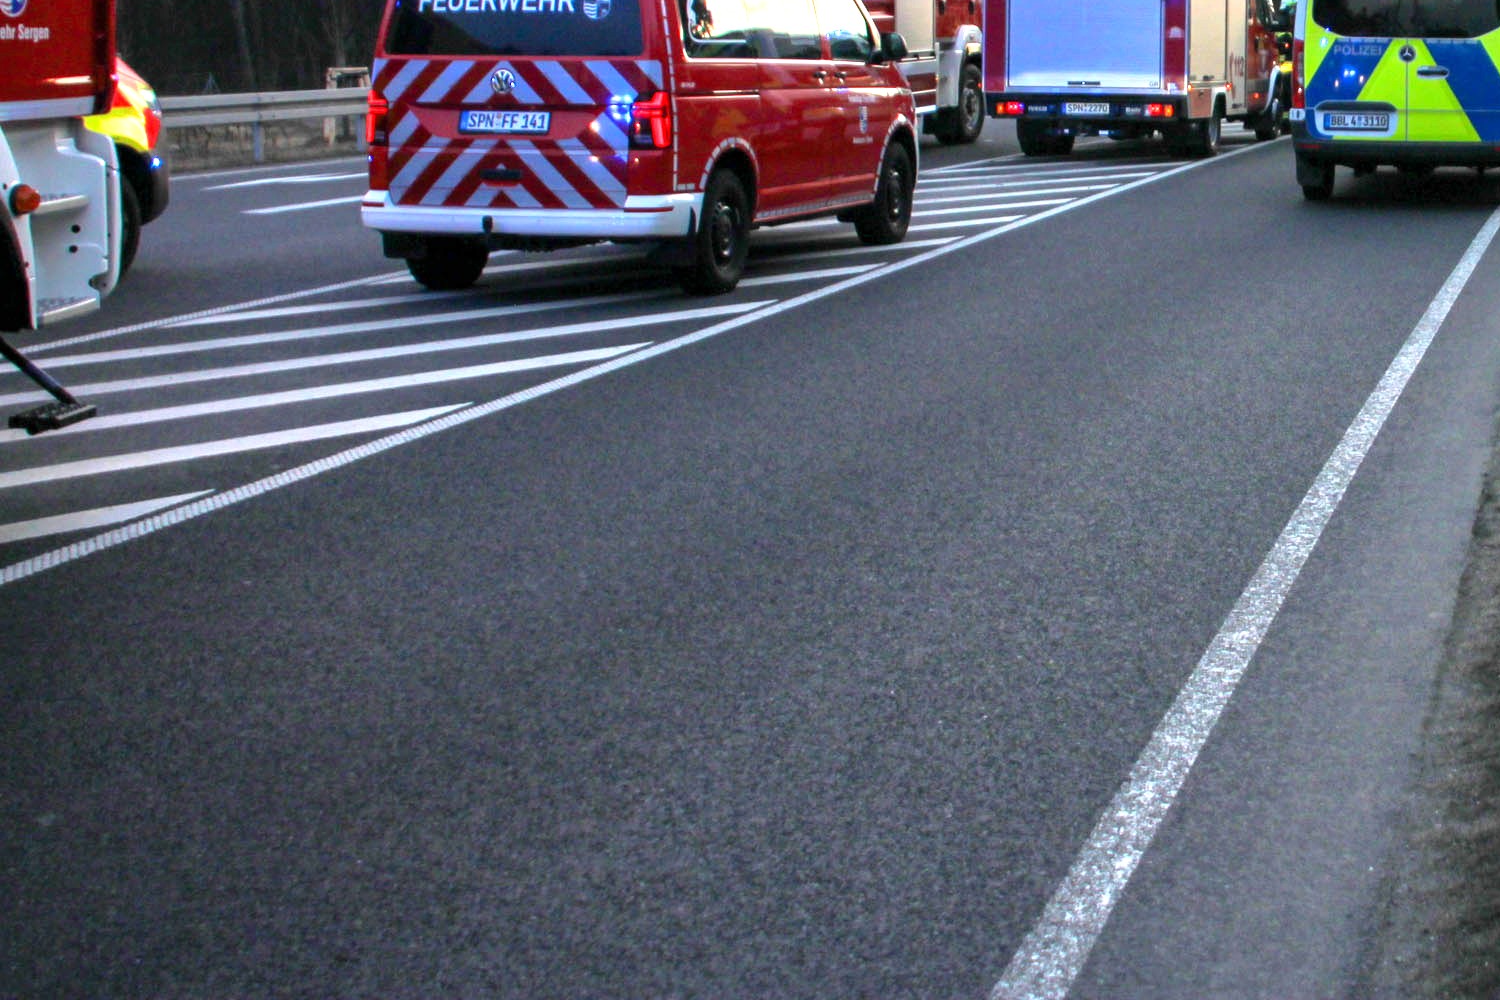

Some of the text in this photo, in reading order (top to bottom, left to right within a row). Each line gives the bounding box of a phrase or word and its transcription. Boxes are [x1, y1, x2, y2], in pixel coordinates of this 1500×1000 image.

[1333, 44, 1382, 56] POLIZEI
[1067, 103, 1083, 112] SPN
[468, 113, 546, 129] SPN FF 141
[1350, 115, 1356, 126] 4
